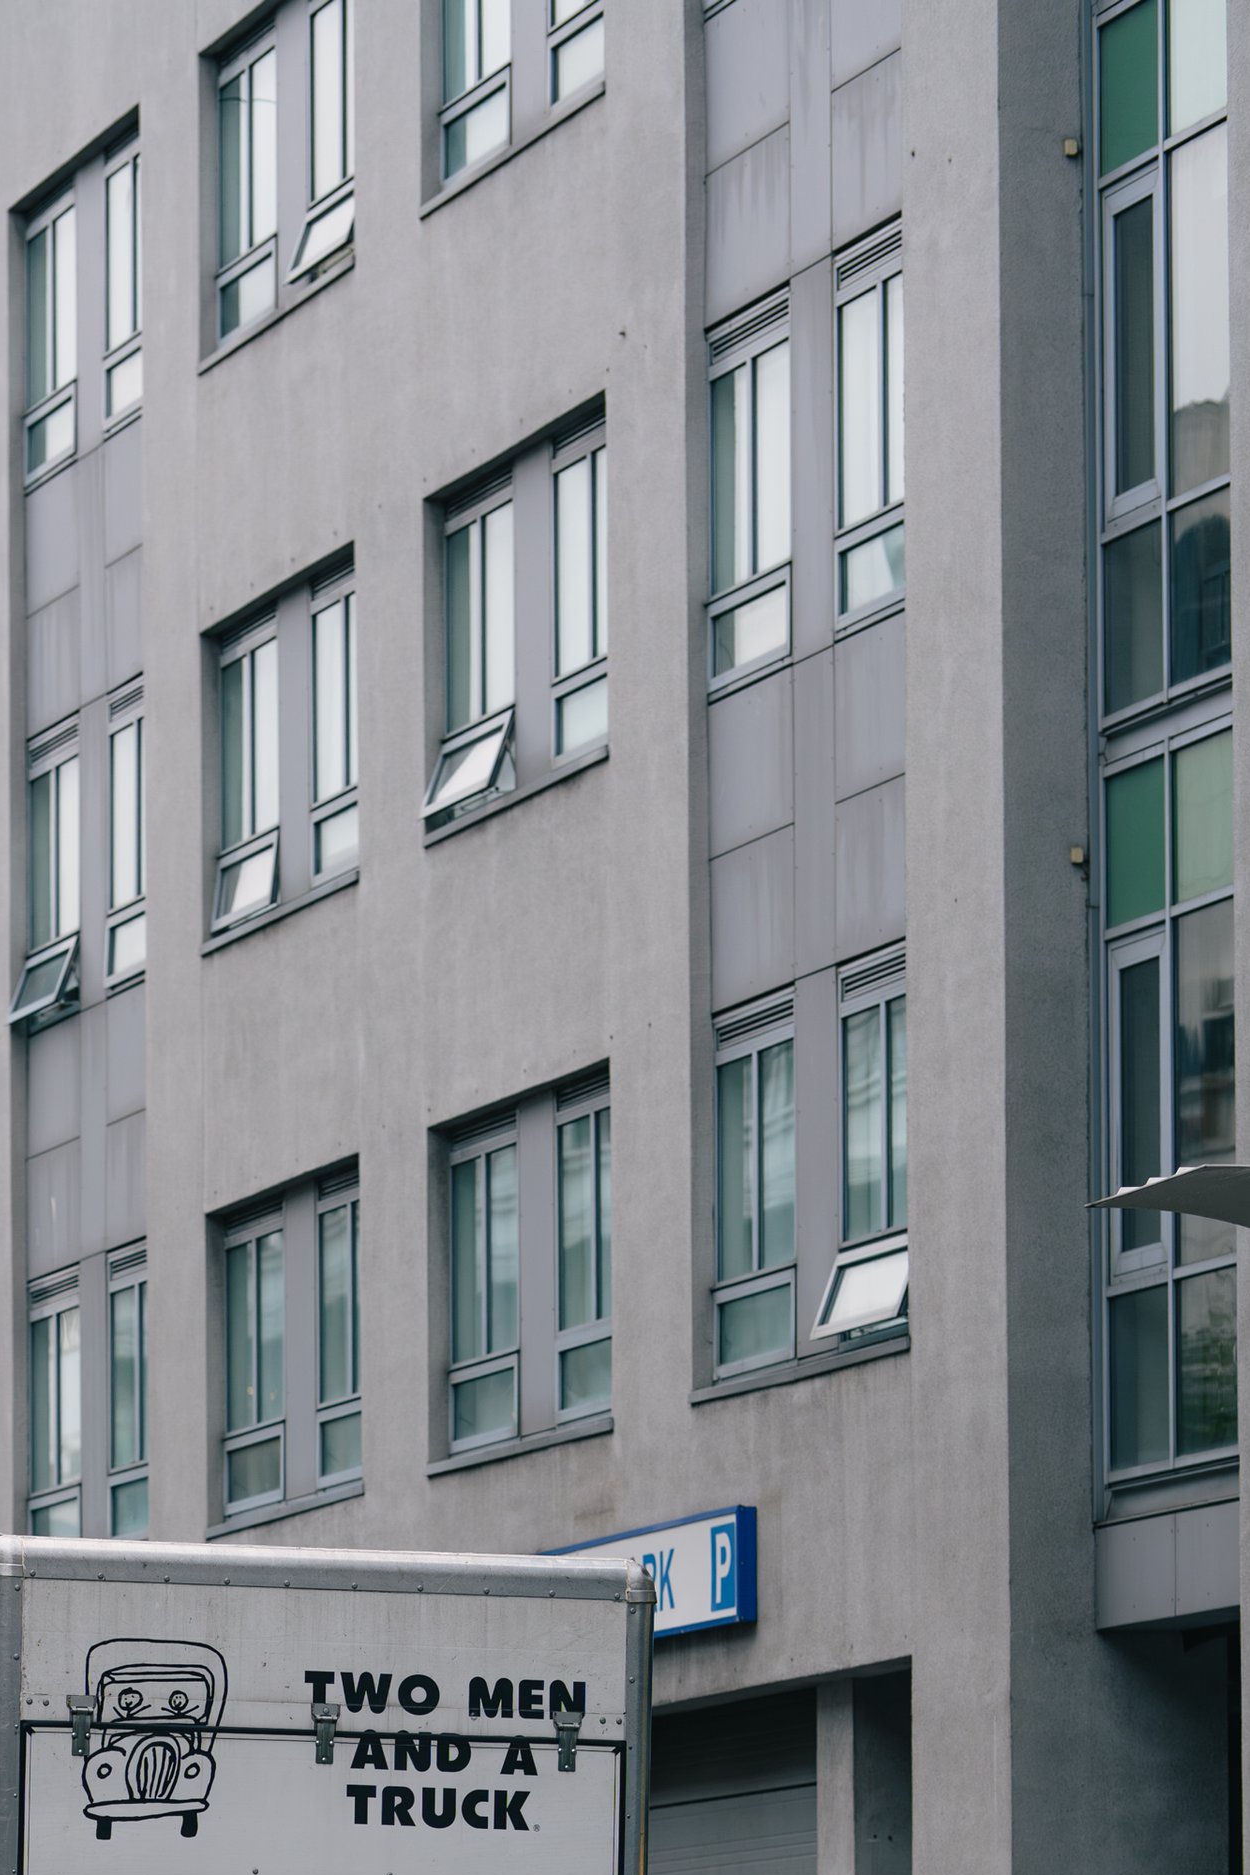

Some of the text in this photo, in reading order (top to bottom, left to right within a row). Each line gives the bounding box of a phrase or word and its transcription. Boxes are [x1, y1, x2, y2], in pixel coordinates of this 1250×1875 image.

[715, 1532, 731, 1604] P
[305, 1670, 586, 1719] TWO MEN
[350, 1729, 538, 1776] AND A
